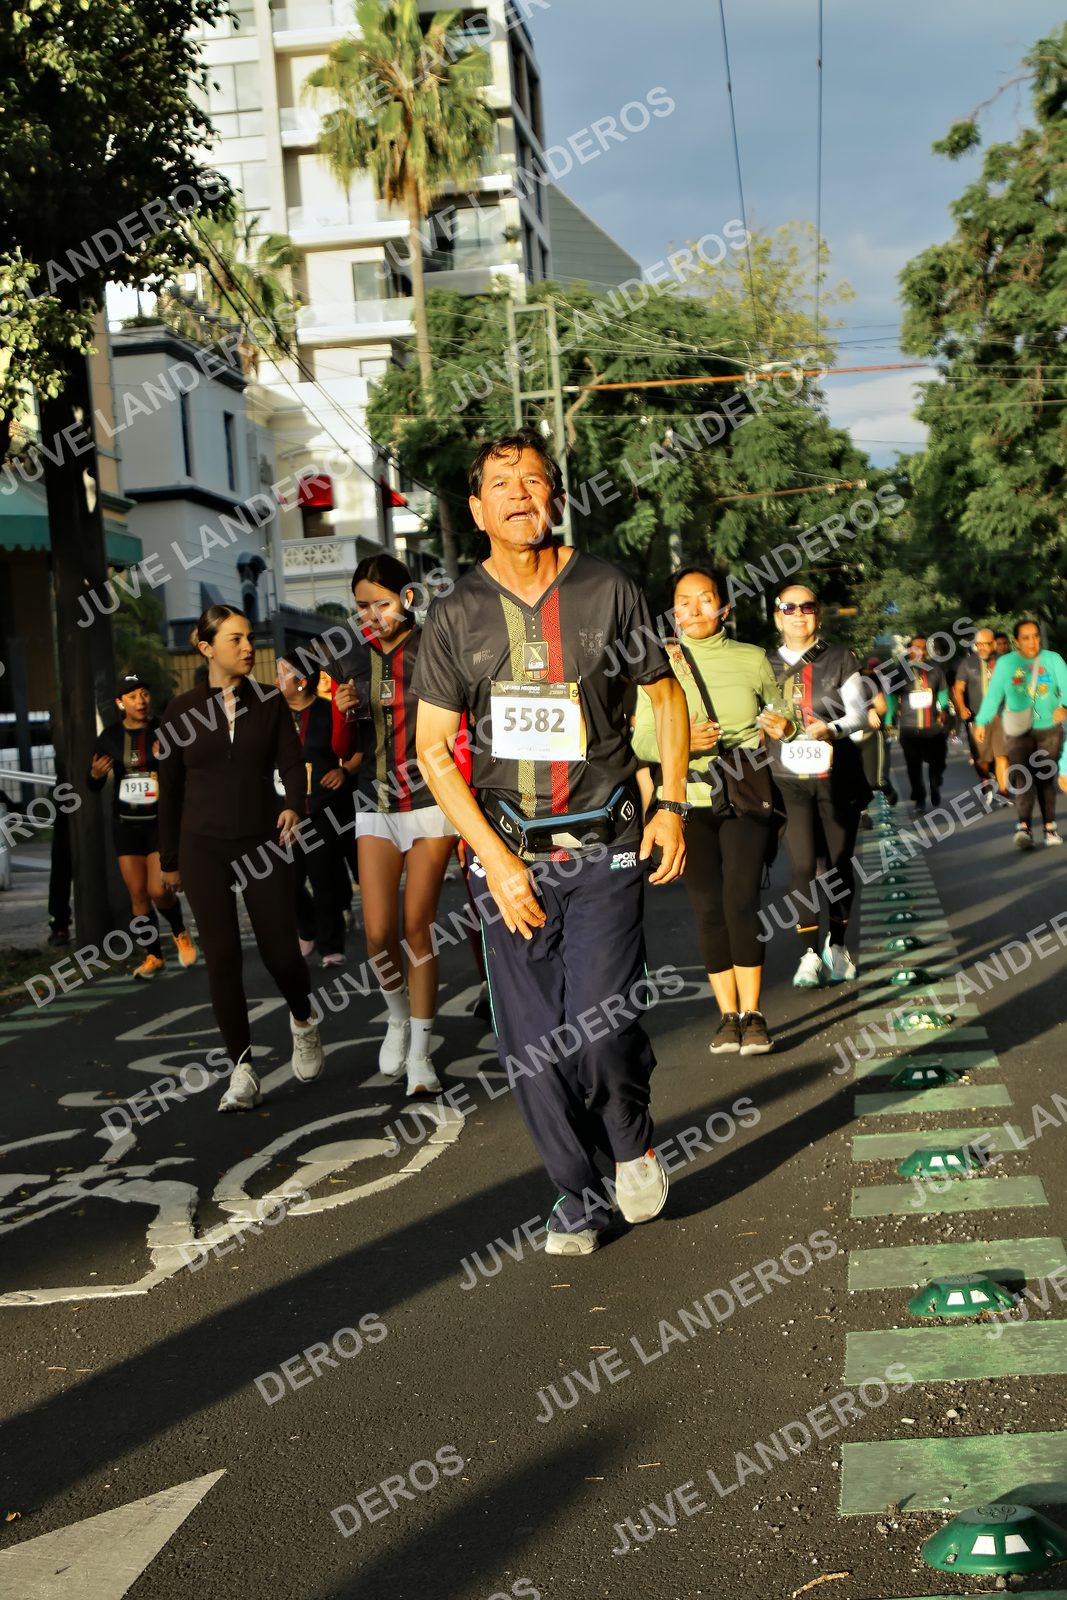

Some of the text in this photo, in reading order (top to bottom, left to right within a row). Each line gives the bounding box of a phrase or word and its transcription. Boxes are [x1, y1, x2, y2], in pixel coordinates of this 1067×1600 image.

[503, 707, 565, 733] 5582
[788, 746, 822, 759] 5958
[125, 782, 150, 793] 1913
[620, 859, 637, 868] CITY
